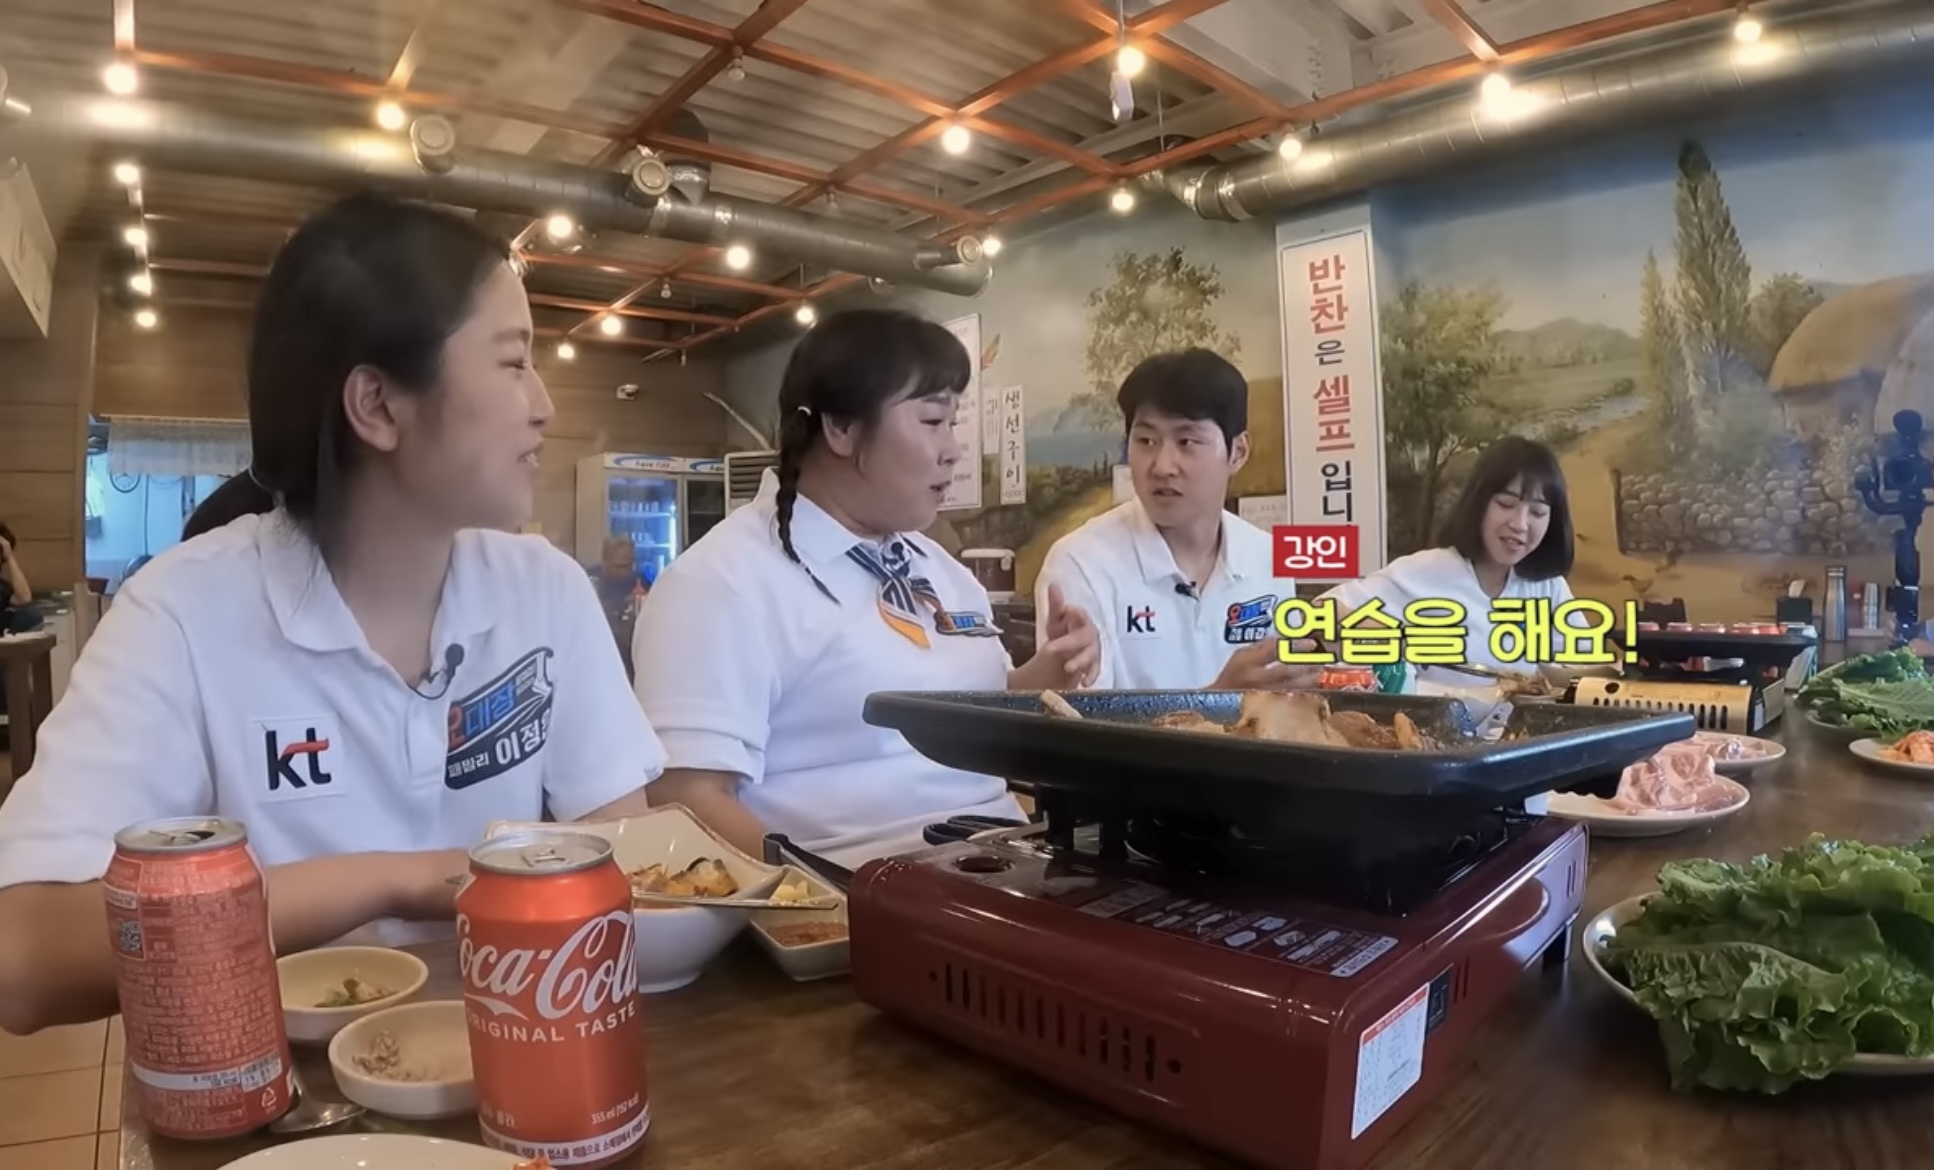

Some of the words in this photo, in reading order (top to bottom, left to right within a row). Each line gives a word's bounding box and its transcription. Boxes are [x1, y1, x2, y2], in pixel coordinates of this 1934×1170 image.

[1308, 254, 1348, 366] 반찬은
[1004, 390, 1021, 484] 생선구이
[1313, 374, 1355, 453] 셀프
[1320, 460, 1353, 527] 입니
[1127, 605, 1156, 633] kt
[265, 726, 333, 791] kt
[576, 1000, 636, 1038] TASTE
